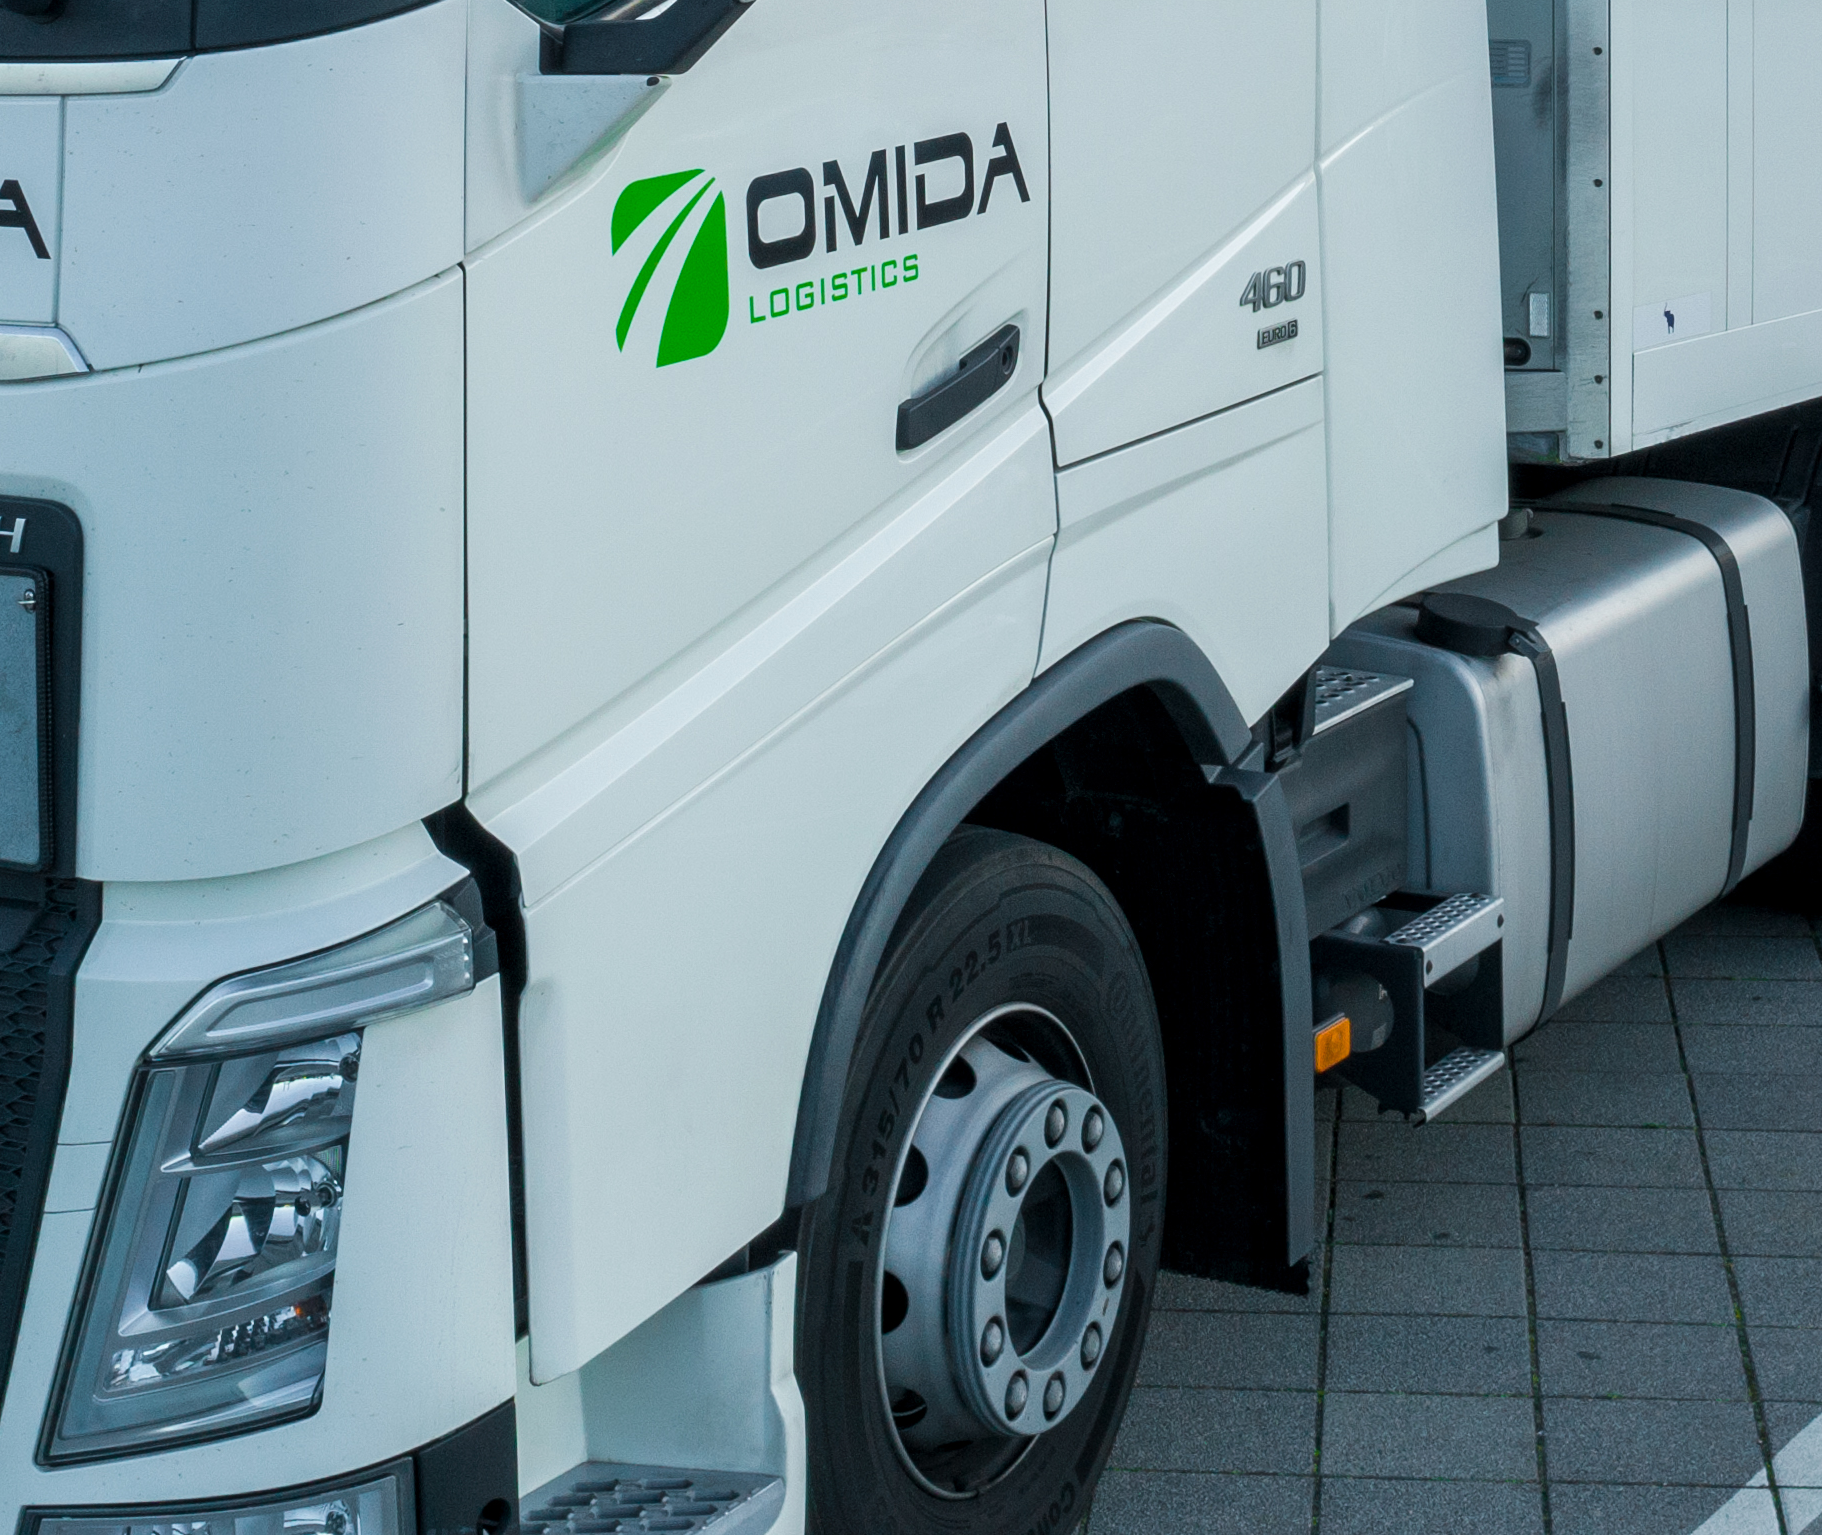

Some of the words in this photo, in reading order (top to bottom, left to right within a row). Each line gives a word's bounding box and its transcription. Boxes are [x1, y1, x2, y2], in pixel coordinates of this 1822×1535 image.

[746, 121, 1030, 270] OMIDA
[749, 253, 920, 324] LOGISTICS
[1239, 259, 1306, 313] 460
[1262, 325, 1287, 345] EURO
[1288, 320, 1298, 338] 6
[861, 1032, 924, 1198] 315/70
[925, 994, 946, 1035] R
[948, 929, 1002, 1005] 22.5
